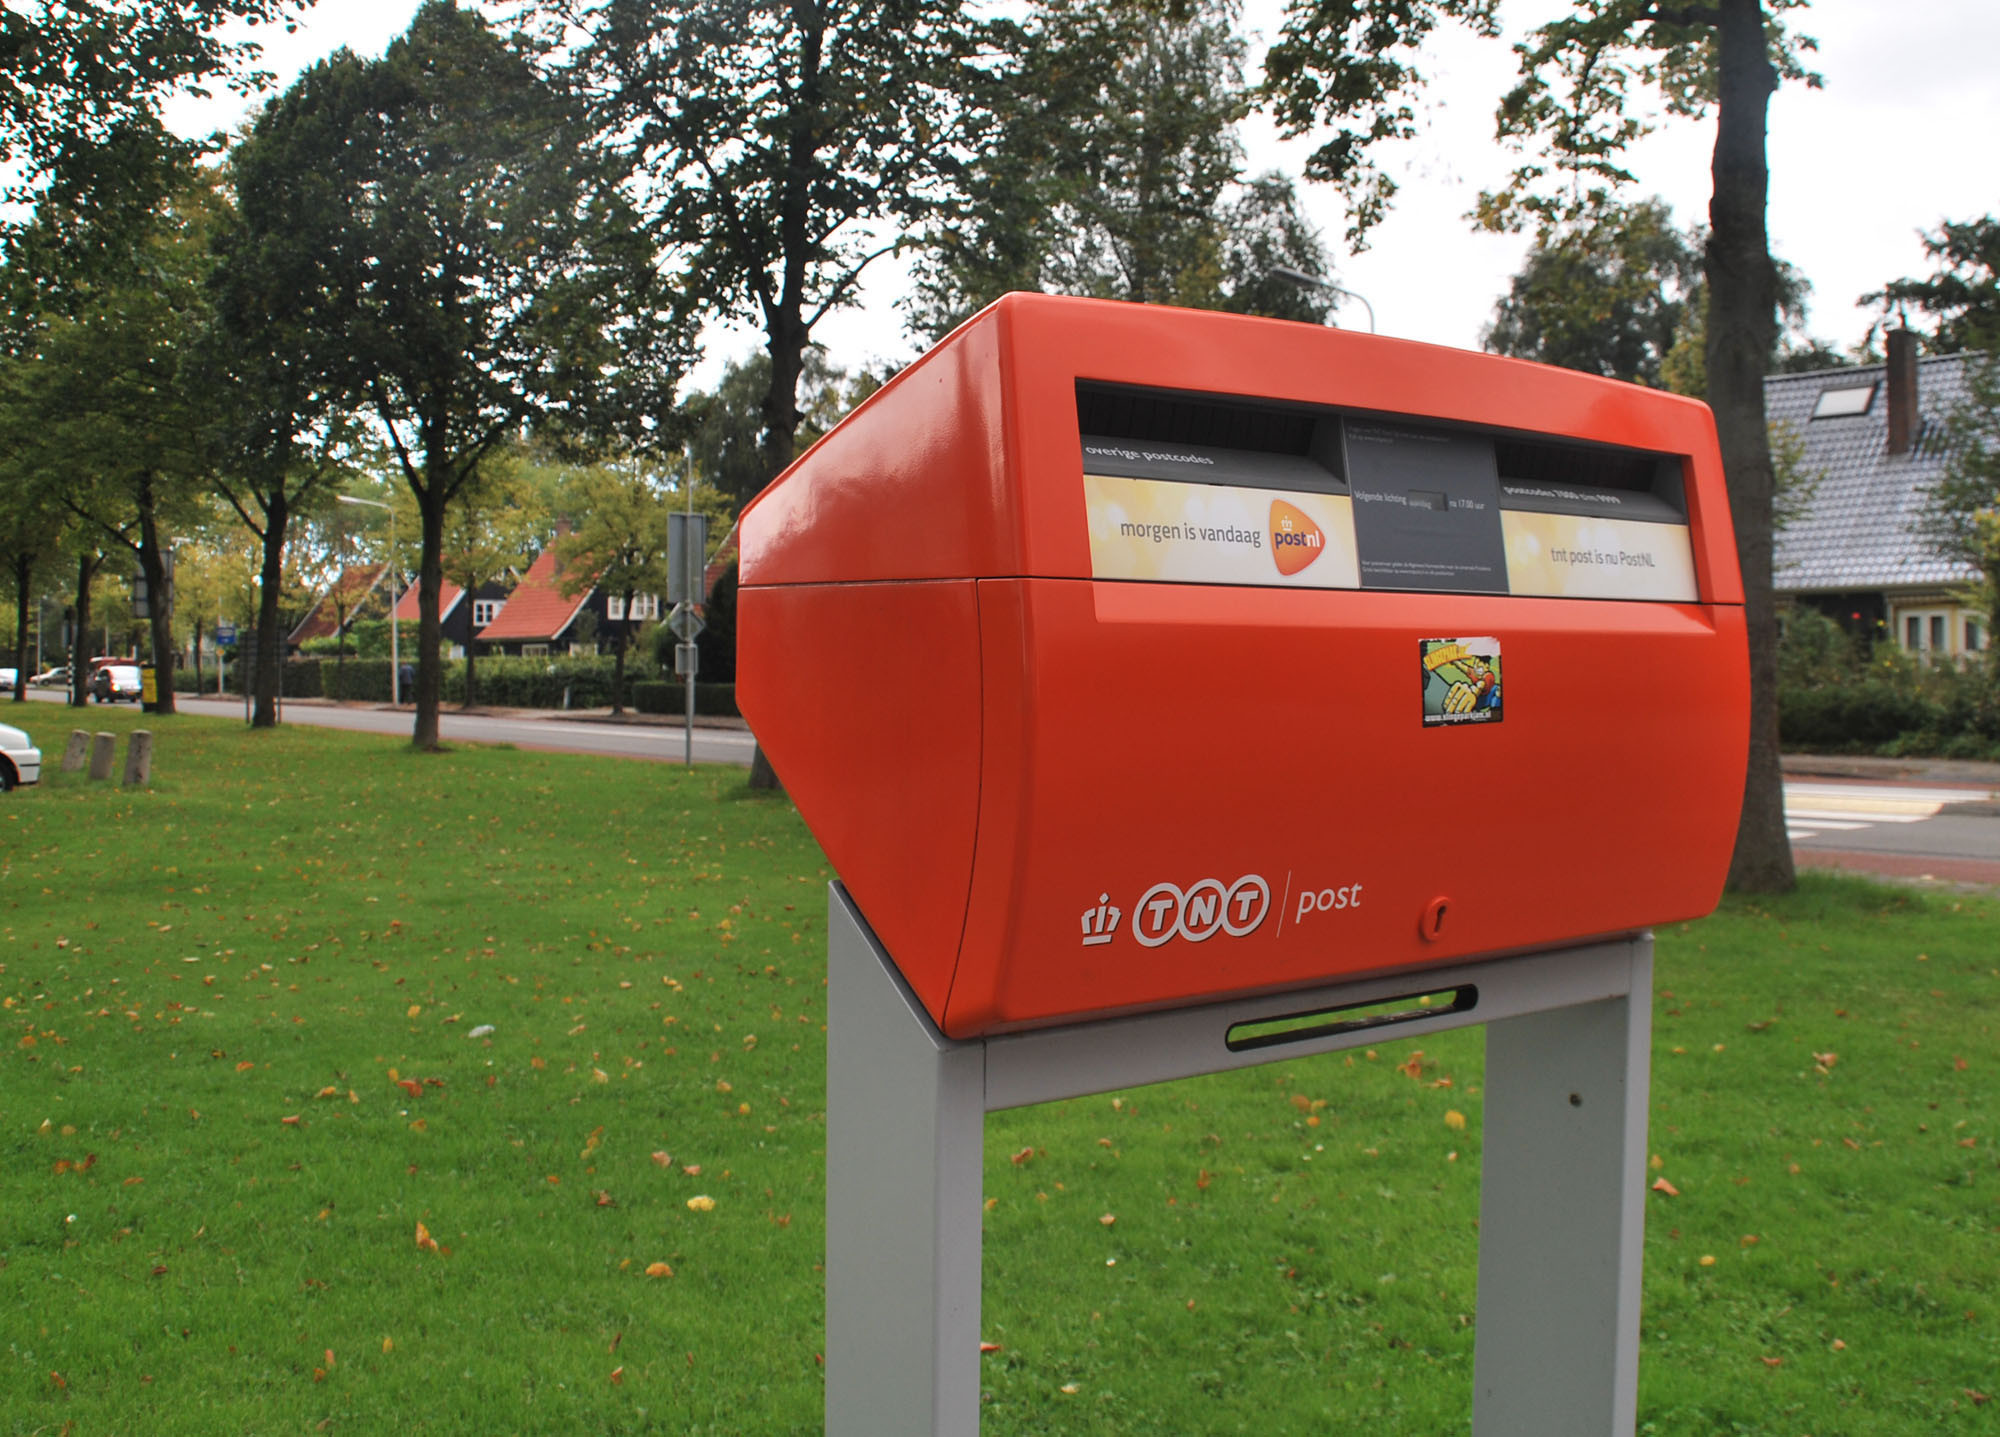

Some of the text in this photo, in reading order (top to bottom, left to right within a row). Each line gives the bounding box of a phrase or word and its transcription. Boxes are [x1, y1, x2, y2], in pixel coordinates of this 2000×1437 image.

[1085, 446, 1214, 465] overige postcodes
[1121, 522, 1261, 549] morgen is vandaag
[1274, 530, 1320, 550] postnl
[1551, 547, 1656, 568] tnt post is nu PostNL
[1296, 882, 1363, 924] post
